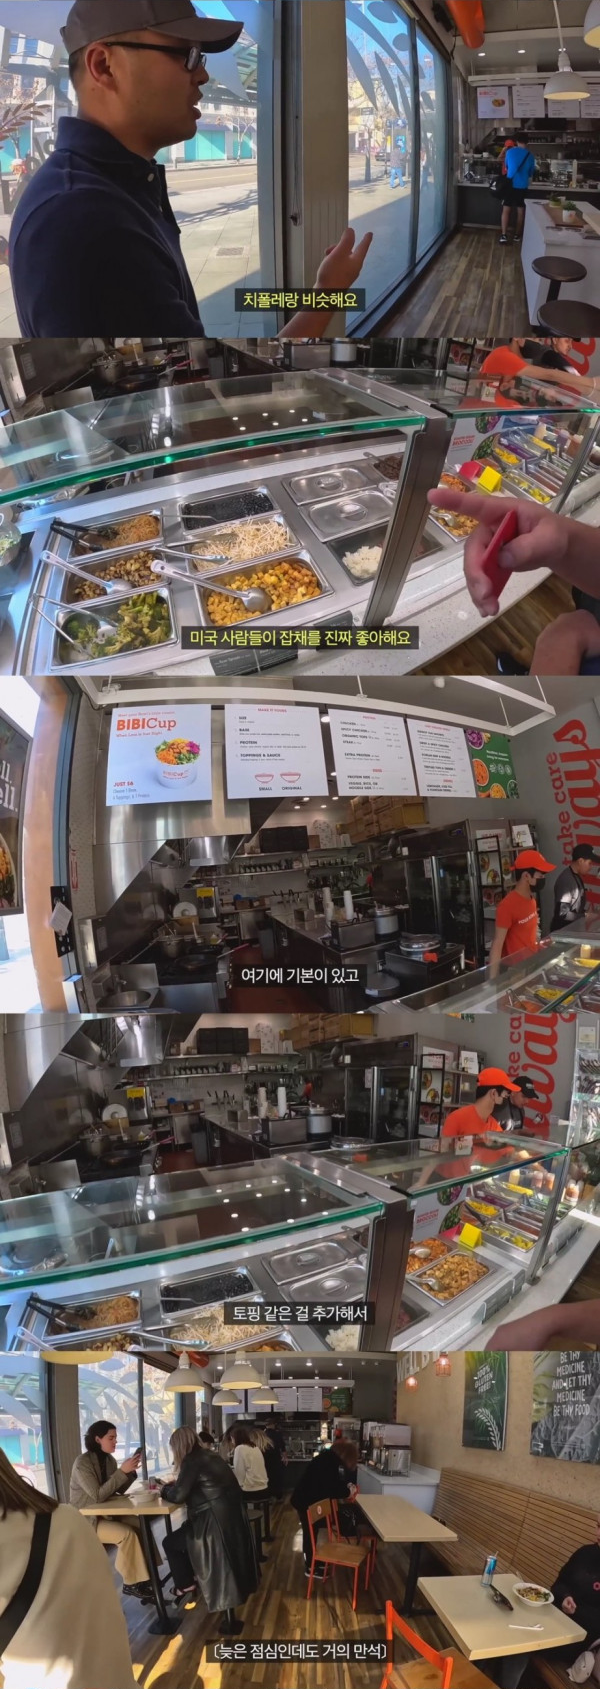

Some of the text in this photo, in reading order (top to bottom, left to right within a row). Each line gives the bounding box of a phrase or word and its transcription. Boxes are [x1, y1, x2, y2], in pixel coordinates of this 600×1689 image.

[116, 717, 177, 731] BIBICup
[546, 751, 567, 804] care
[560, 1351, 580, 1364] BE THY
[556, 1361, 585, 1377] MEDICINE
[552, 1373, 592, 1391] AND LET THY
[556, 1389, 585, 1403] MEDICINE
[553, 1403, 590, 1417] BE THY FOOD
